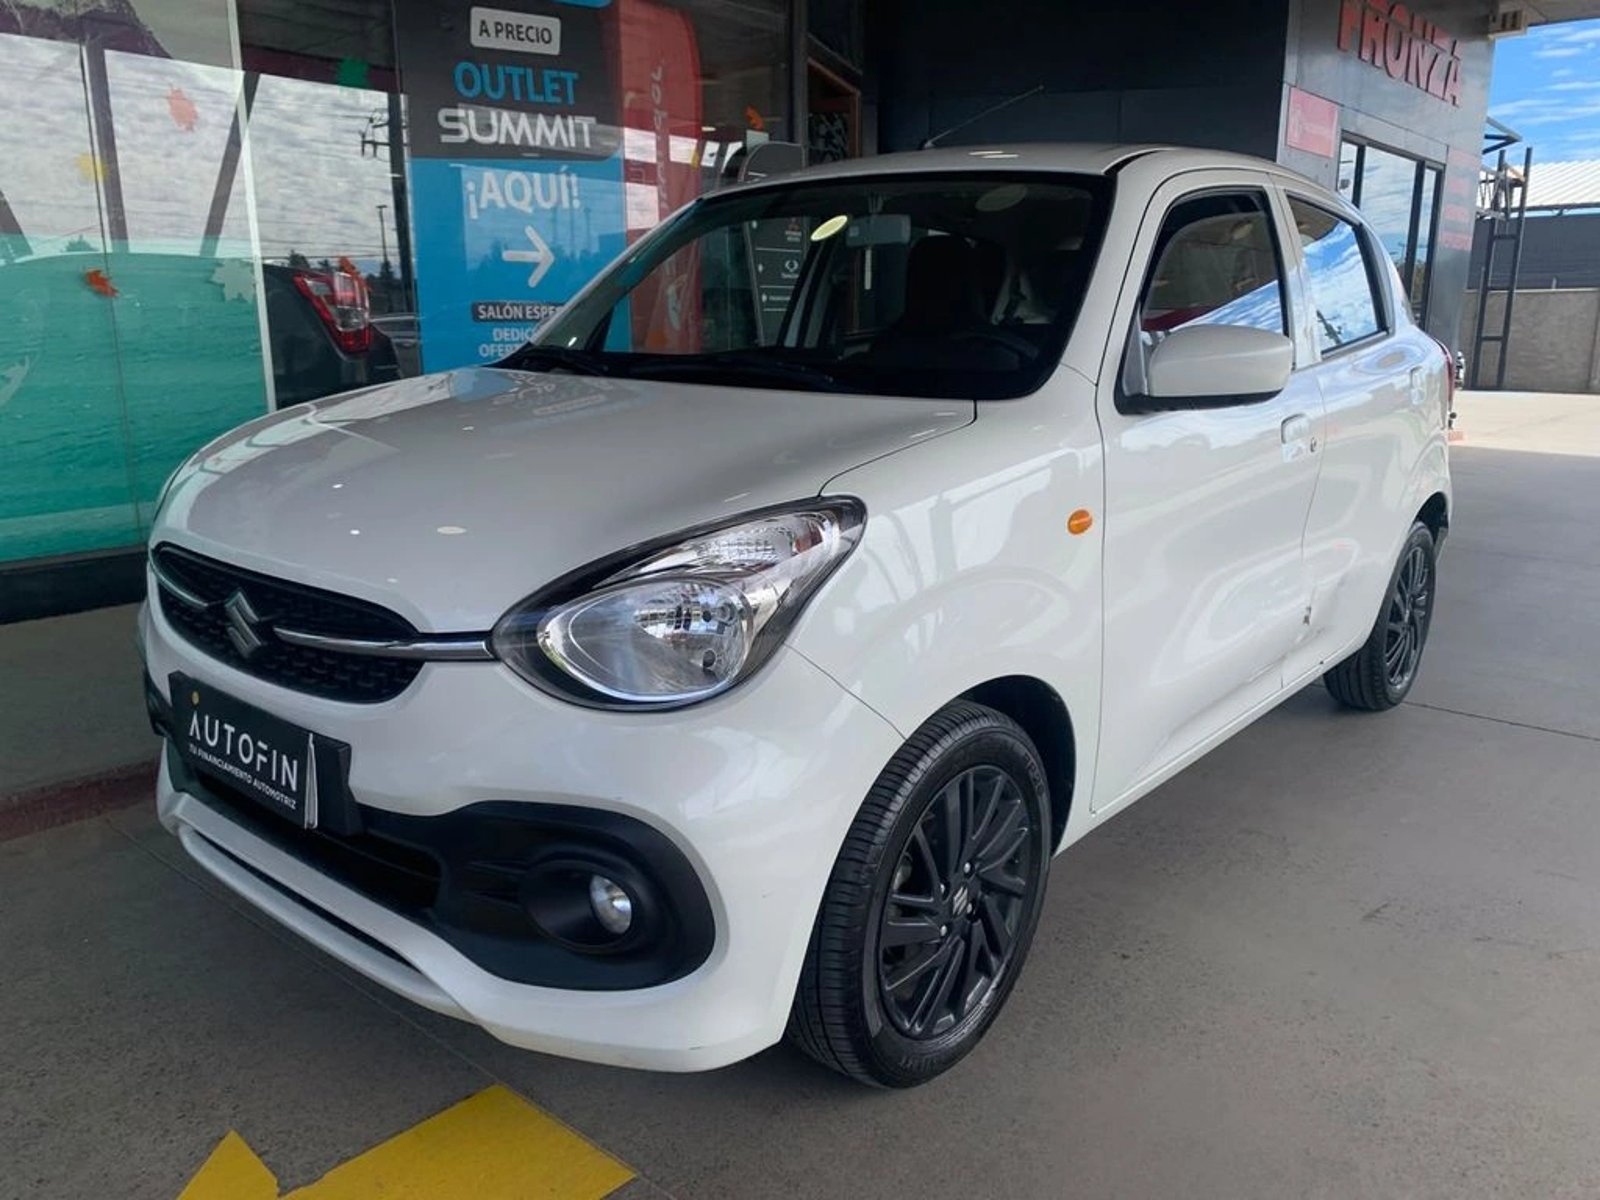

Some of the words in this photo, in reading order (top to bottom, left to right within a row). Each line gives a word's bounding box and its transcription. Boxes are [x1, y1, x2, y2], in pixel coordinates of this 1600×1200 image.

[478, 20, 491, 38] A
[494, 22, 553, 45] PRECIO
[454, 61, 579, 105] OUTLET
[437, 107, 597, 148] SUMMIT
[466, 165, 581, 219] ¡AQUÍ!
[478, 302, 524, 320] SALÓN
[493, 327, 535, 342] DEDIC
[189, 711, 298, 792] AUTOFIN
[198, 748, 252, 784] FINANCIAMIENTO
[253, 778, 297, 811] AUTOMOTRIZ
